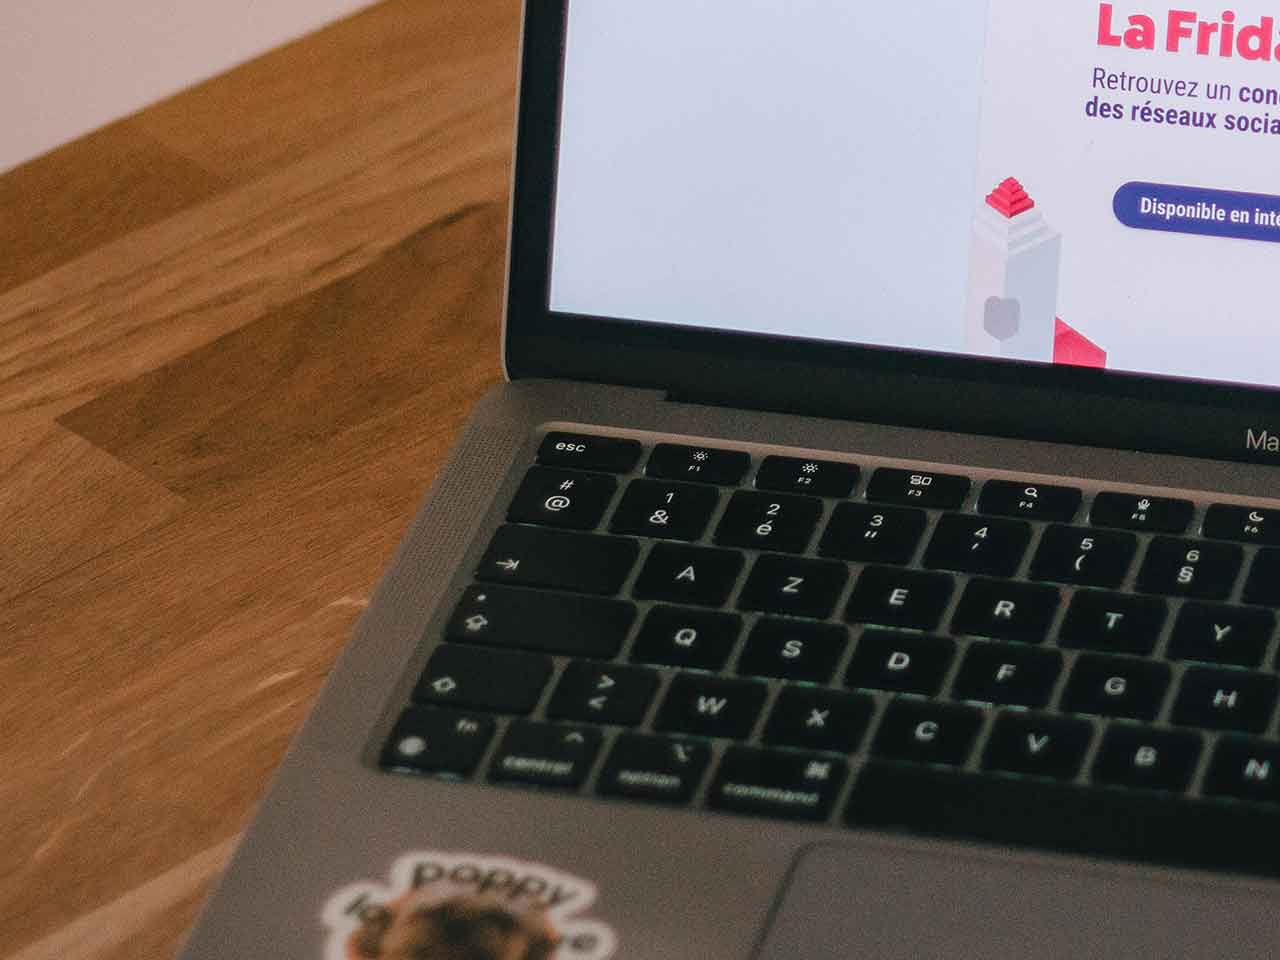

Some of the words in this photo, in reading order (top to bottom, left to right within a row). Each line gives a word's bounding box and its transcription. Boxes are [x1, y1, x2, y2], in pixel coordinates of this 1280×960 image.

[1097, 3, 1155, 52] La
[1092, 67, 1198, 98] Retrouvez
[1207, 81, 1231, 101] un
[1085, 96, 1124, 120] des
[1131, 101, 1217, 129] réseaux
[1140, 196, 1226, 225] Disponible
[1230, 208, 1249, 224] en
[556, 441, 586, 452] esc
[676, 565, 696, 580] A
[782, 576, 804, 592] Z
[889, 588, 908, 605] E
[993, 600, 1016, 617] R
[1105, 611, 1124, 628] T
[1213, 623, 1232, 640] Y
